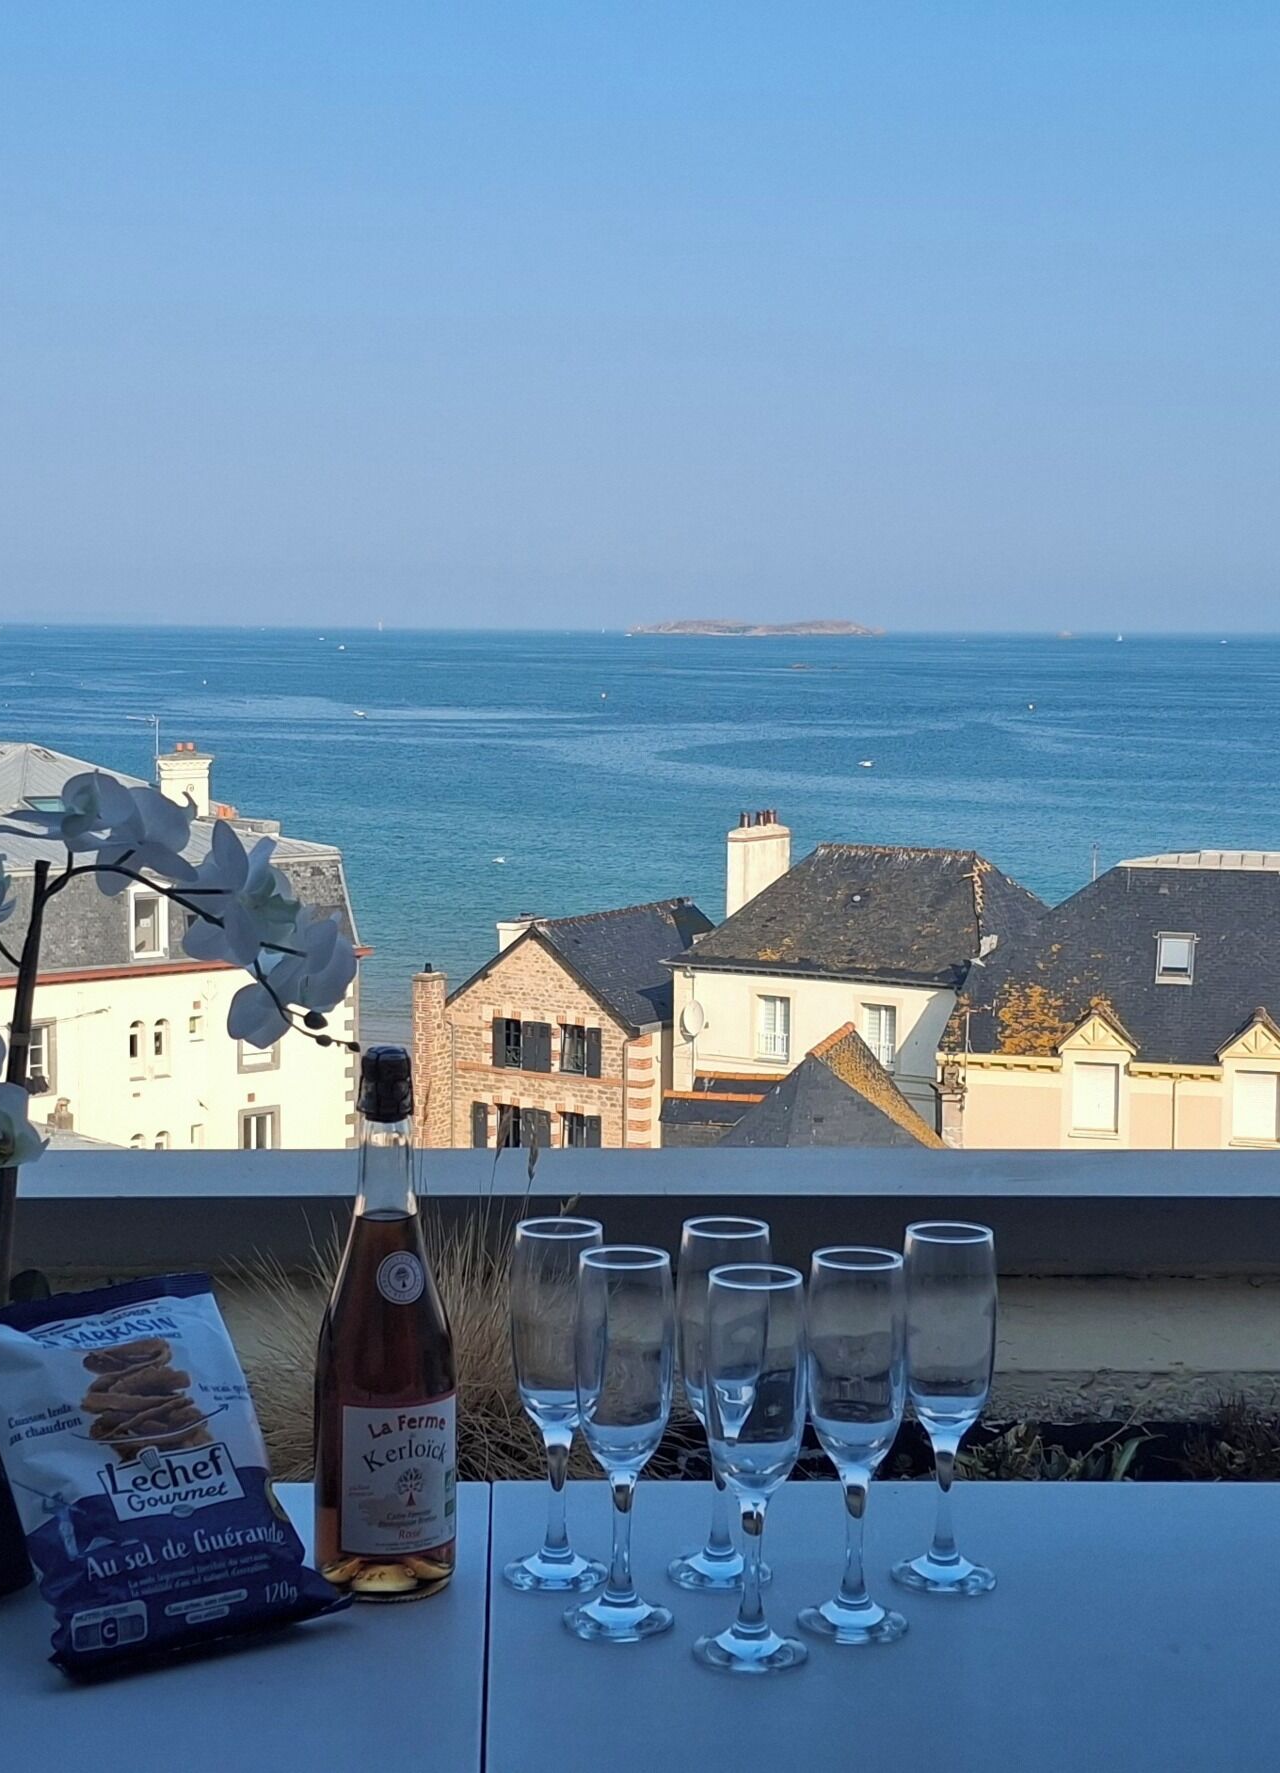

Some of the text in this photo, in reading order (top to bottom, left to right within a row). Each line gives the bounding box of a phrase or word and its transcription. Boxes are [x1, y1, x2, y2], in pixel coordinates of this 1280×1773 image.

[62, 1317, 178, 1344] SARRASIN
[25, 1416, 83, 1439] chaudron
[368, 1414, 446, 1439] La Ferme
[361, 1440, 446, 1473] Kerloïck
[104, 1447, 222, 1495] Lechef
[127, 1481, 229, 1512] Gourmet
[87, 1556, 121, 1581] Au
[125, 1542, 160, 1570] sel
[161, 1538, 191, 1561] de
[192, 1521, 286, 1554] Guérande
[264, 1581, 298, 1604] 120g
[103, 1623, 116, 1638] C
